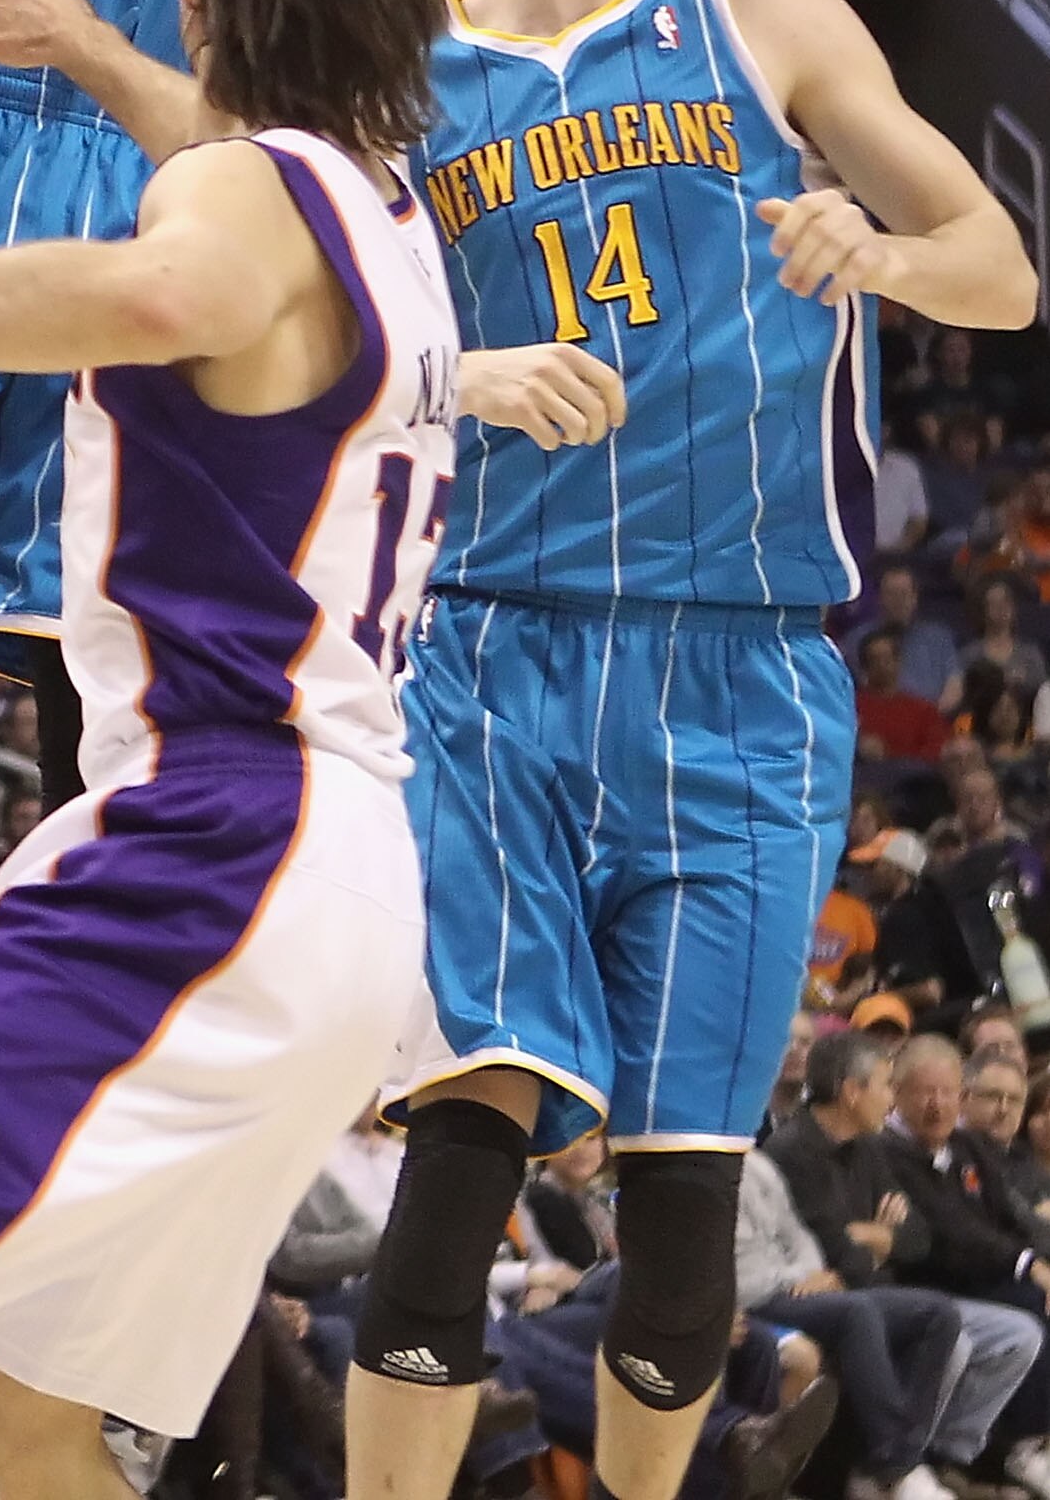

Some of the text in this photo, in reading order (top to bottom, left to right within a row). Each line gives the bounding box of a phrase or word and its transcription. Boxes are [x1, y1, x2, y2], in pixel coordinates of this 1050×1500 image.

[426, 101, 742, 247] NEW ORLEANS
[532, 199, 660, 343] 14
